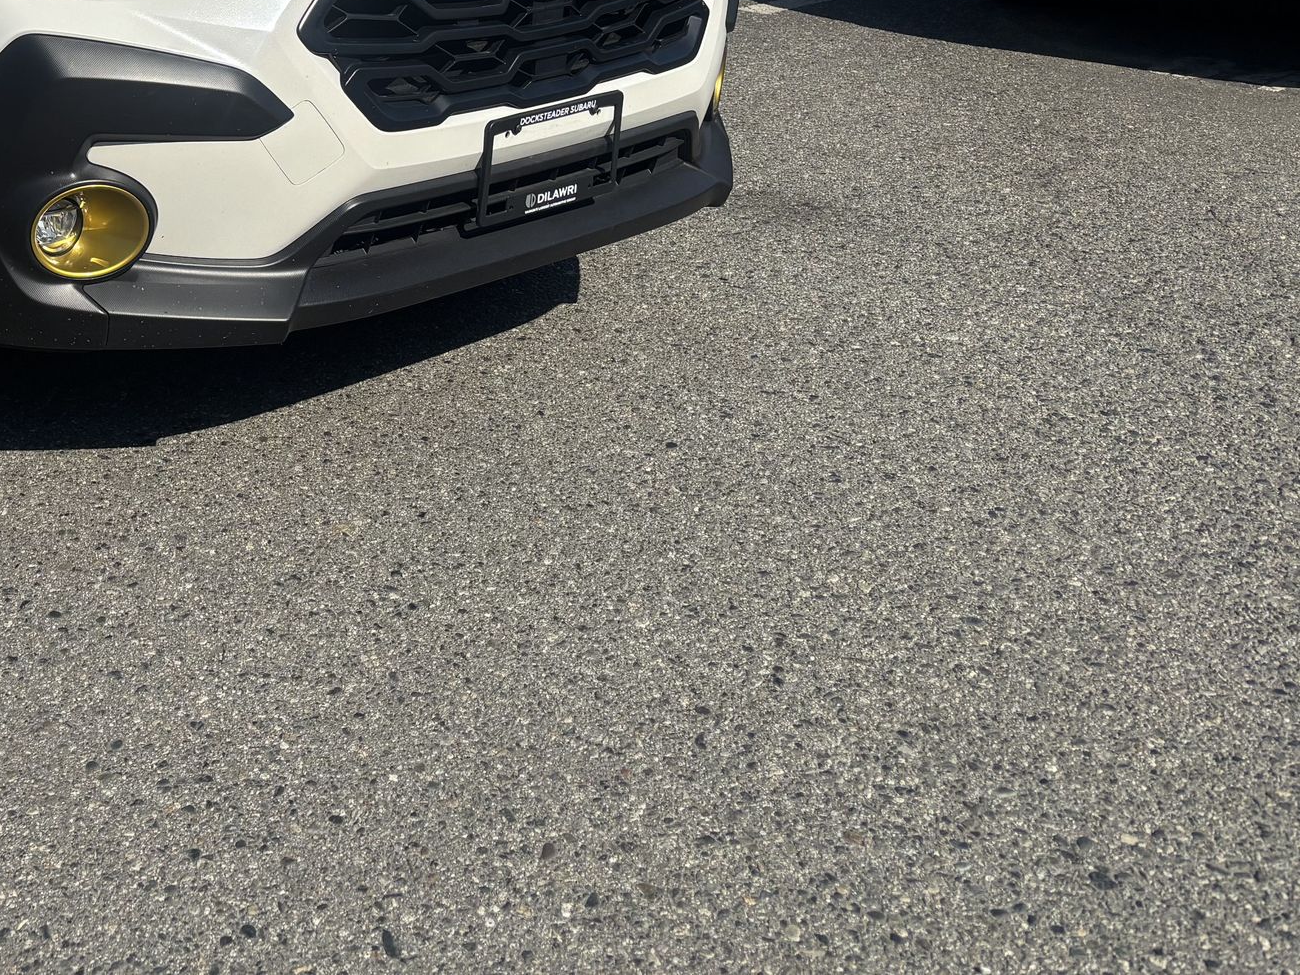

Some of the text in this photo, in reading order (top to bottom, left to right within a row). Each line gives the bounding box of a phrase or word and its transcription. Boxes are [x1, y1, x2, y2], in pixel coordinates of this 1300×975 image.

[520, 100, 597, 126] DOCKSTEADER SUBARU
[537, 183, 578, 204] DILAWRI
